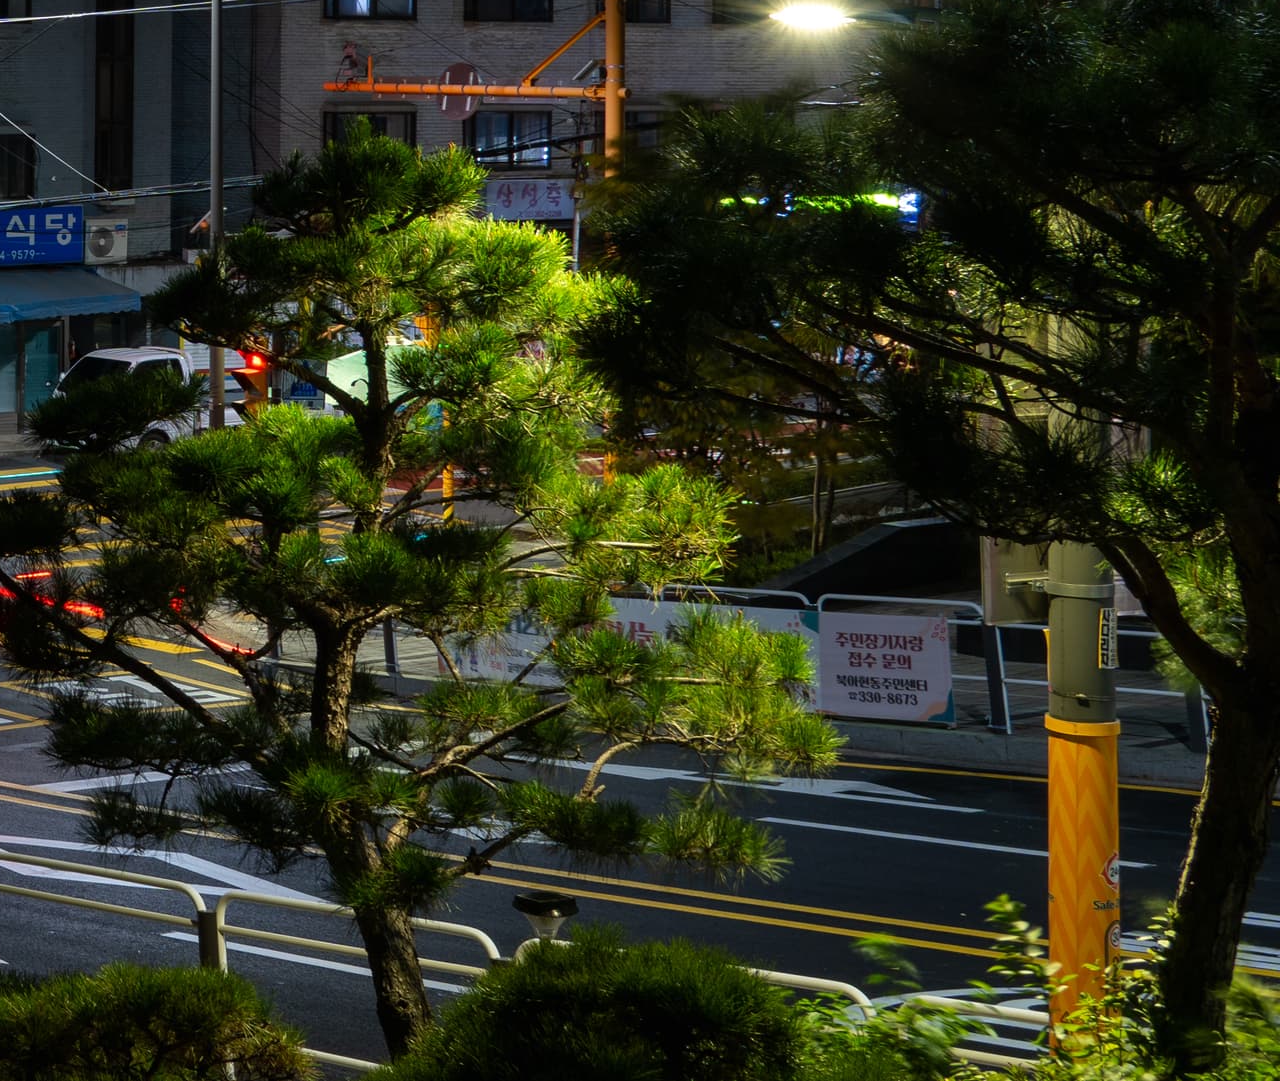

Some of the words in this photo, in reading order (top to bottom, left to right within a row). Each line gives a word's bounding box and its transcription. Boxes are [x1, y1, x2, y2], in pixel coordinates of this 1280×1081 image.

[6, 213, 77, 246] 식당
[835, 631, 925, 652] 주민장기자랑
[848, 651, 877, 668] 접수
[882, 653, 913, 670] 문의
[836, 674, 928, 692] 북아현동주민센터
[858, 690, 919, 706] 330-8673
